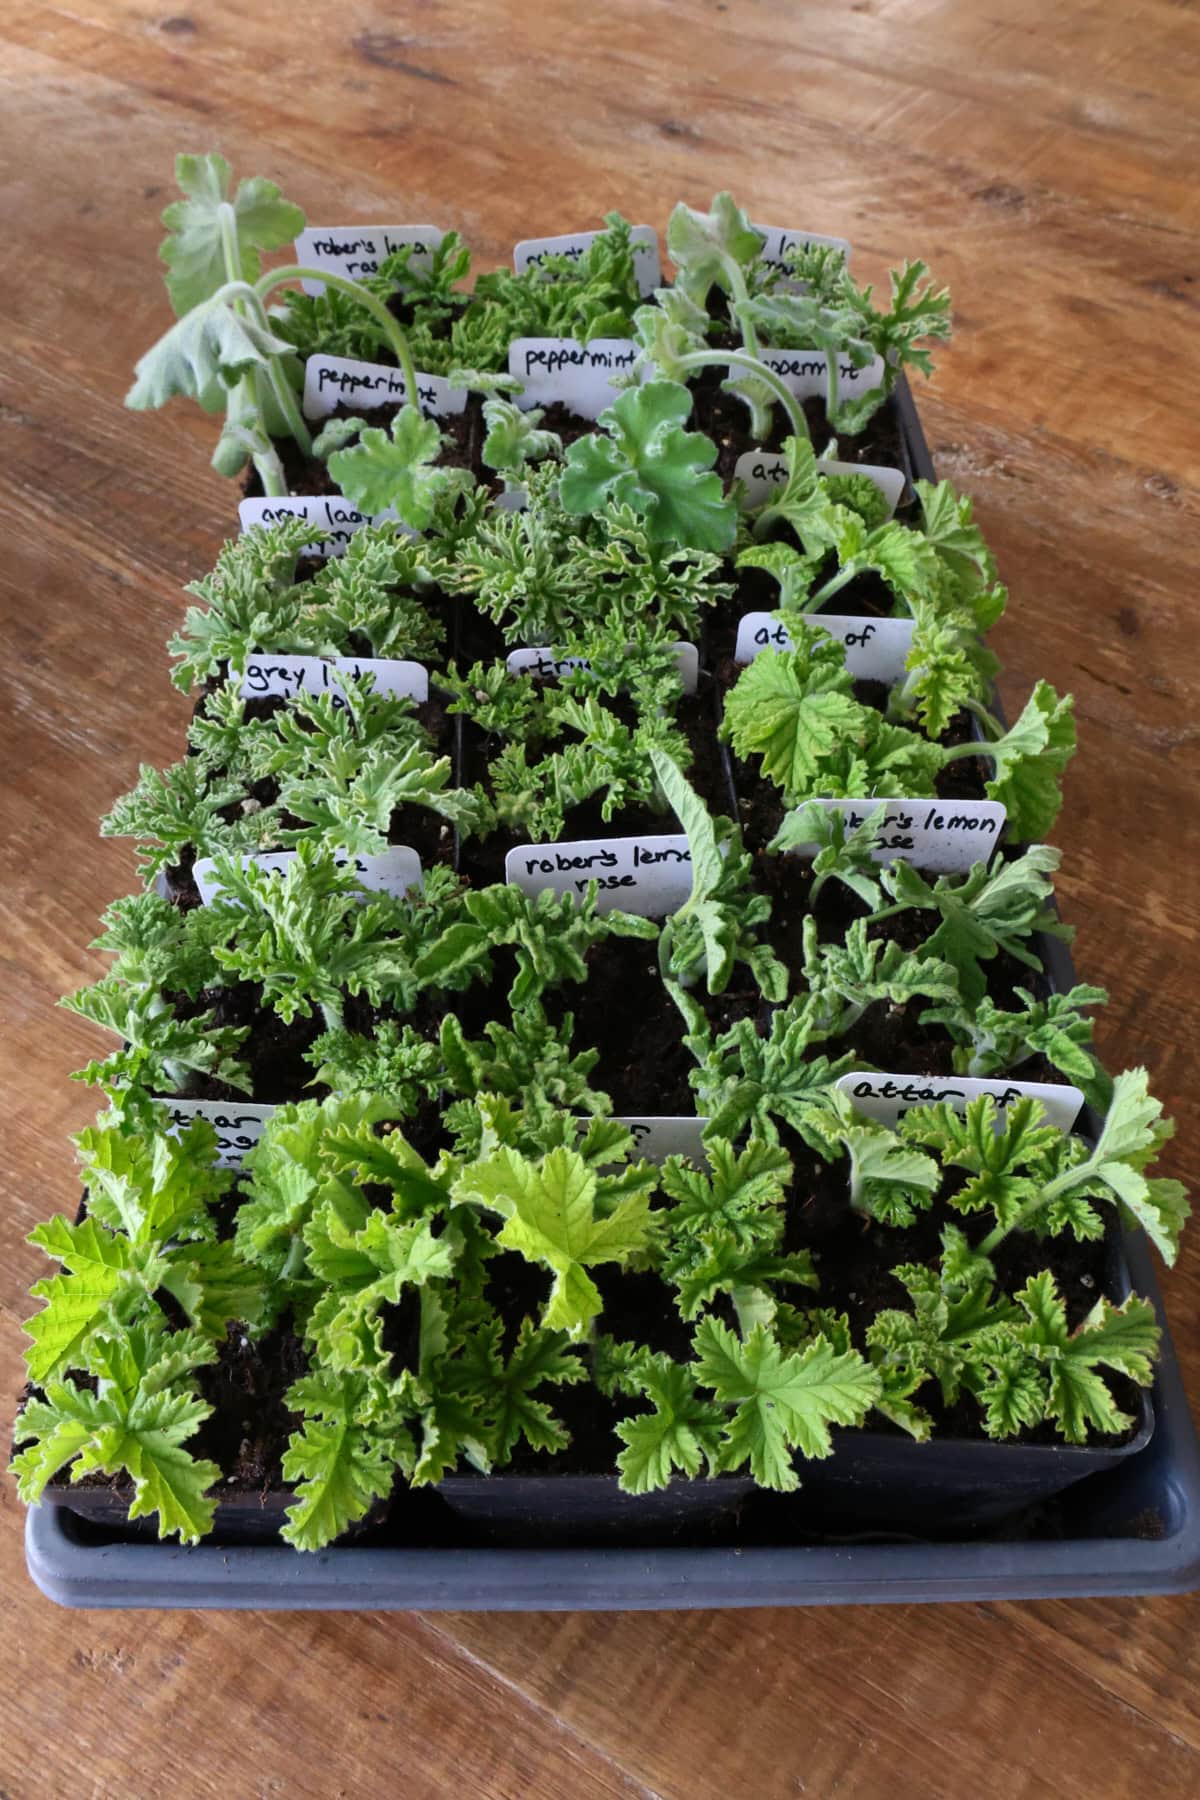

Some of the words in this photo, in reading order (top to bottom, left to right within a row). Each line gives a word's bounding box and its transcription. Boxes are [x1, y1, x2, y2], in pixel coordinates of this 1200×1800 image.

[525, 349, 638, 377] peppermint
[318, 367, 438, 405] peppermnt
[844, 624, 877, 648] of
[247, 664, 306, 692] grey
[923, 807, 996, 834] lemon
[852, 1080, 966, 1101] attar
